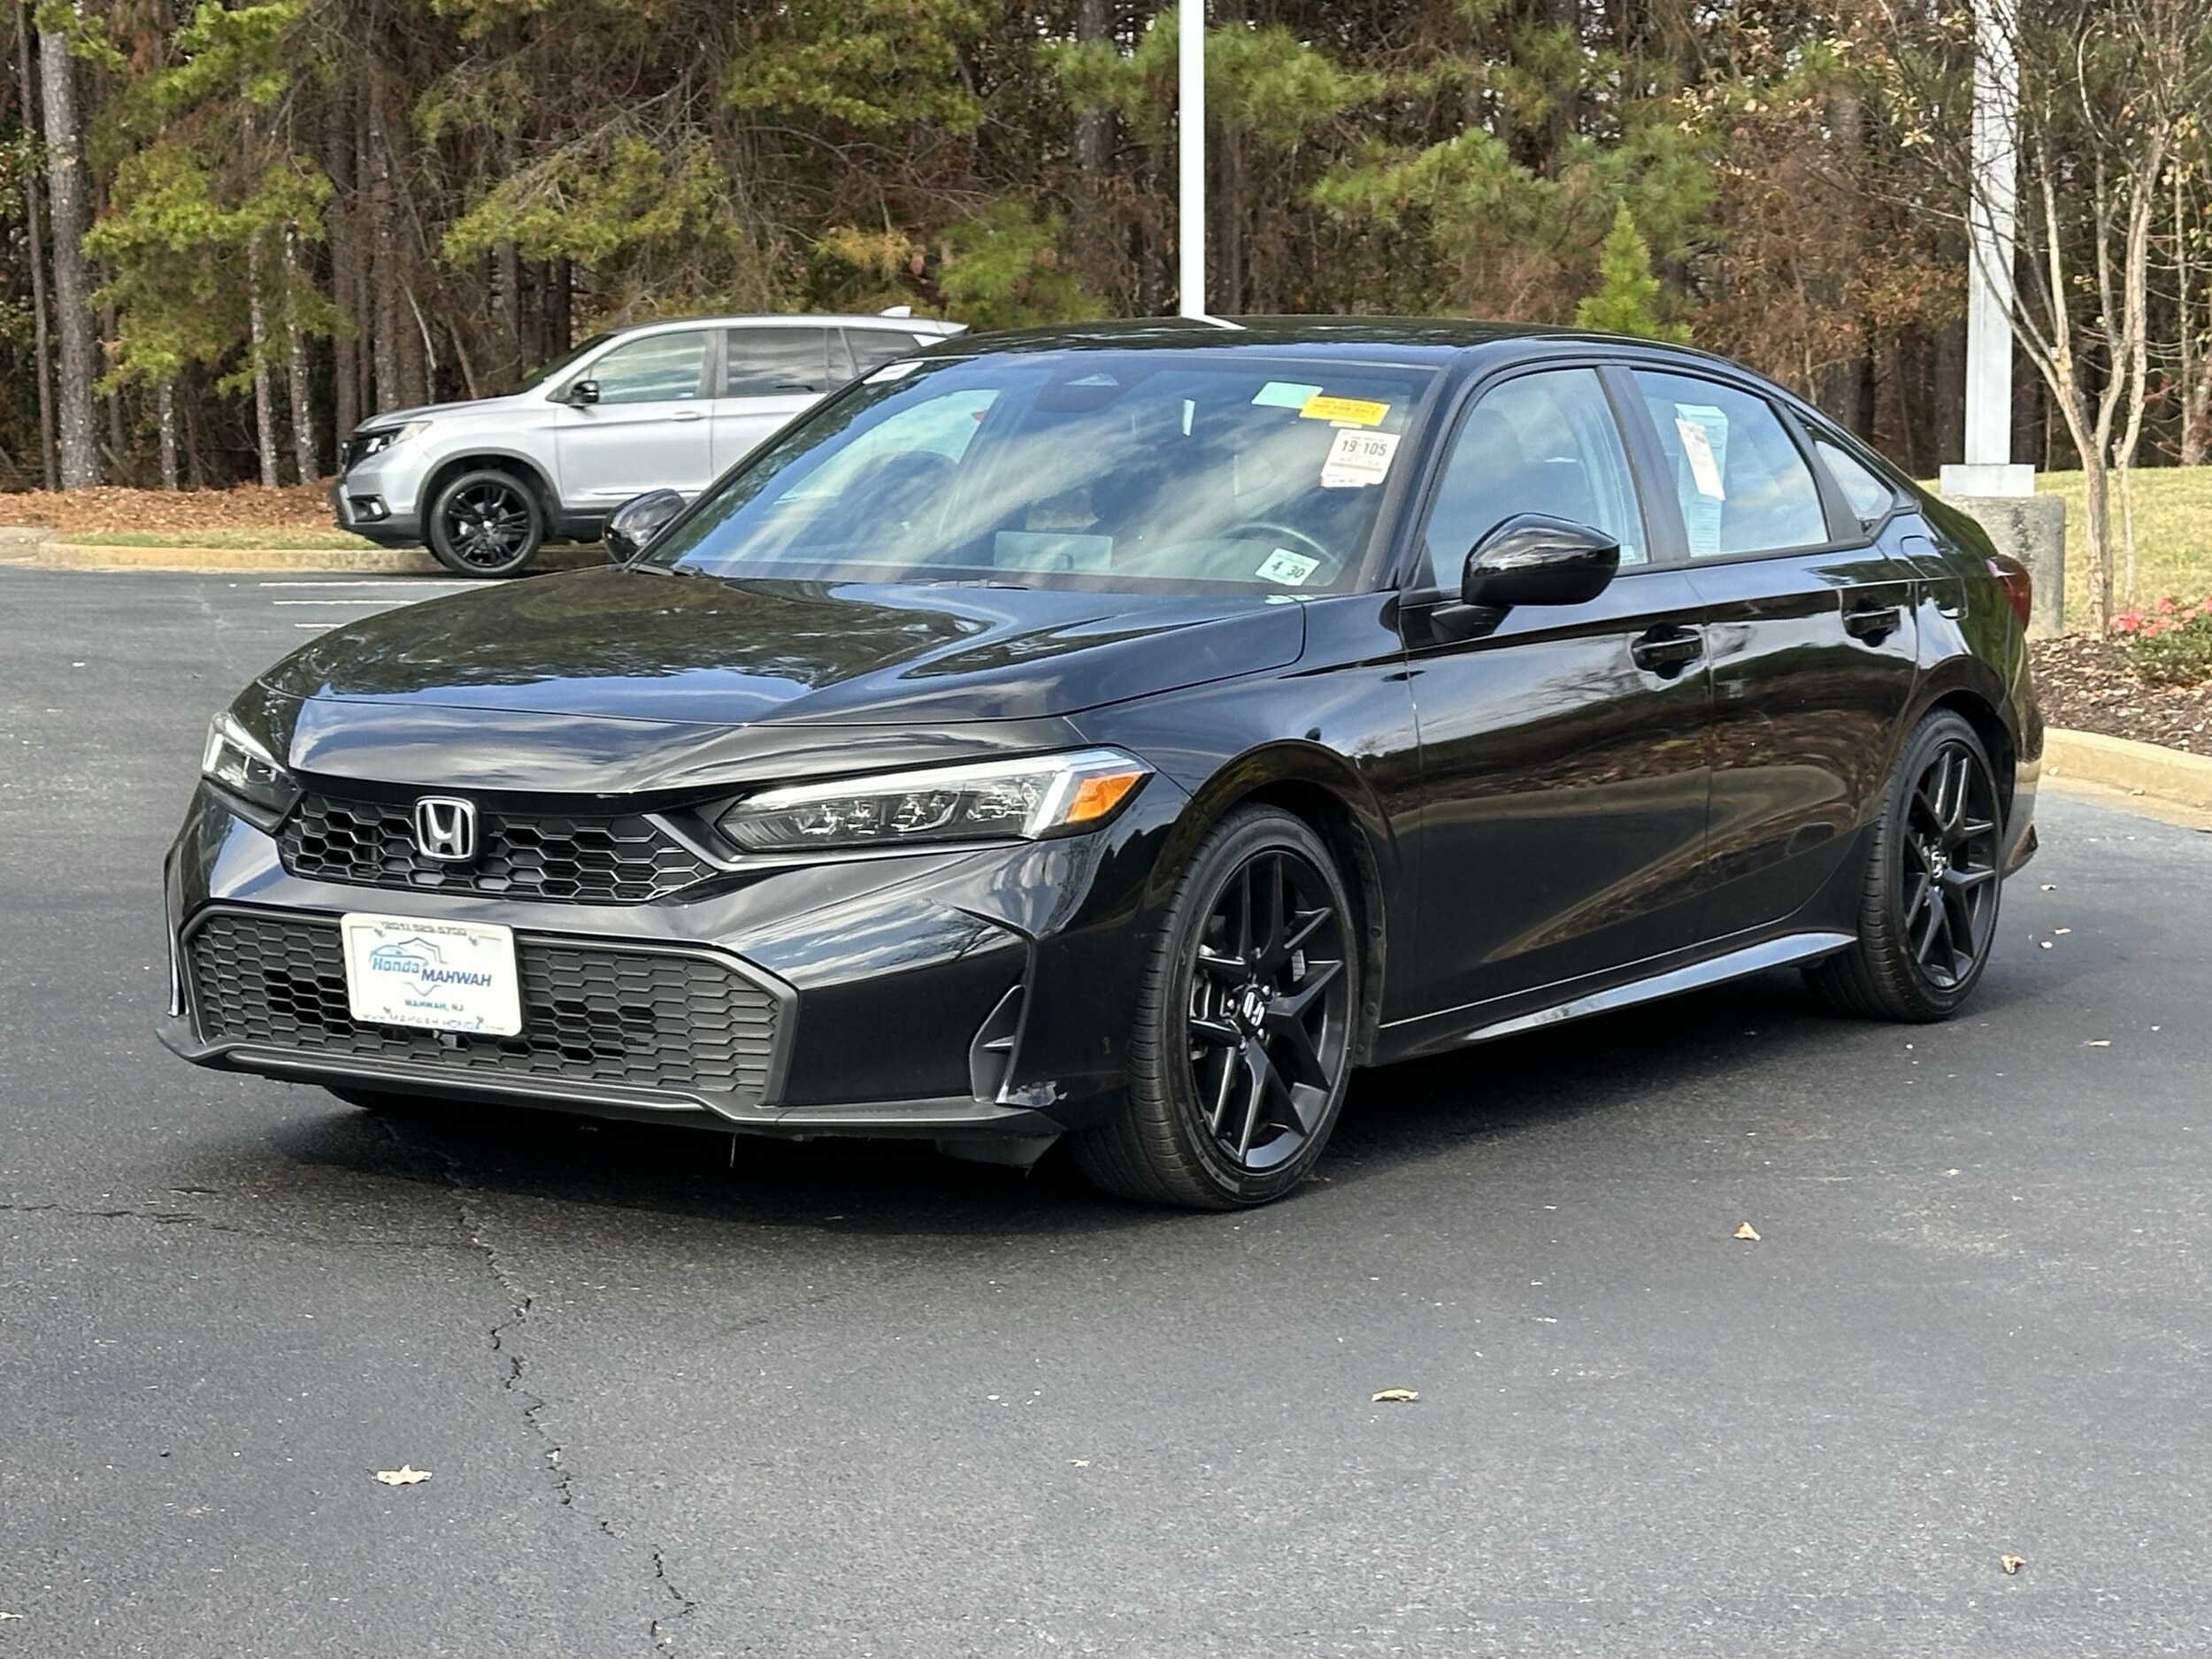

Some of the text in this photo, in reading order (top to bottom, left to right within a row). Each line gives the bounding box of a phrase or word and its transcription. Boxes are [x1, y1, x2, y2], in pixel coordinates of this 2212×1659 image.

[1286, 565, 1306, 579] 30
[373, 957, 492, 987] Honda MAHWAH
